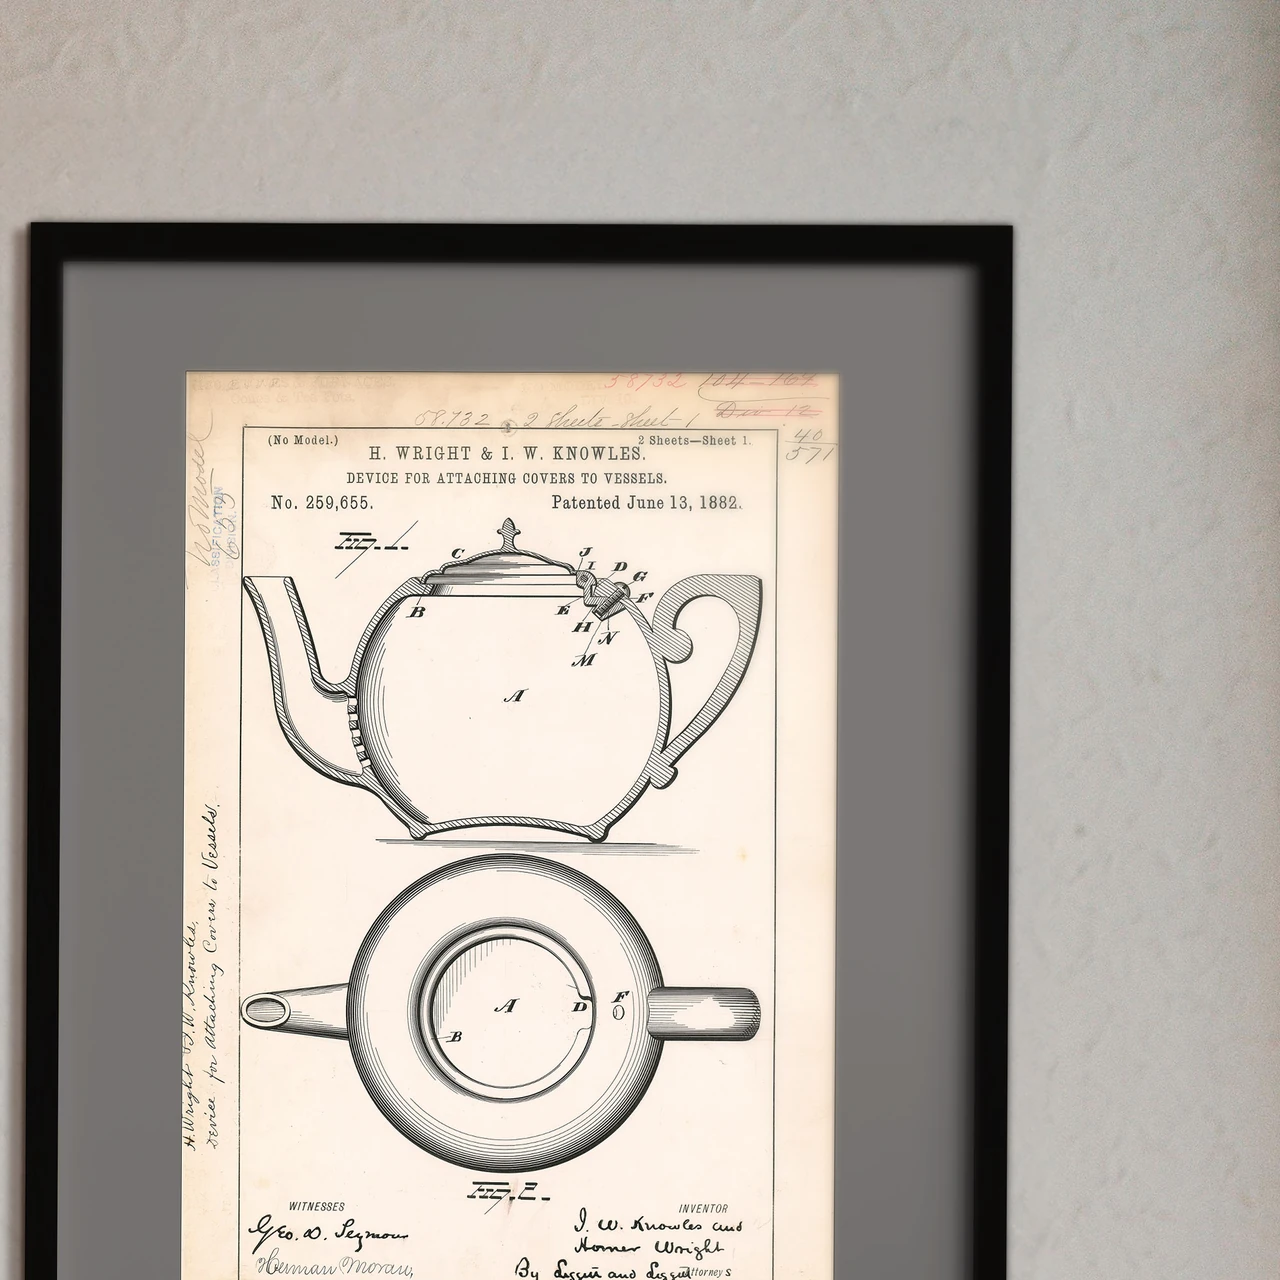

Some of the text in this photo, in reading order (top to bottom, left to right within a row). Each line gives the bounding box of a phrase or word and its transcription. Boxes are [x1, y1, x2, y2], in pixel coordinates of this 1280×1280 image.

[267, 434, 339, 447] (No Model.)
[638, 435, 645, 446] 2
[368, 446, 646, 461] H. WRIGHT & I. W. KNOWLES.
[346, 472, 668, 485] DEVICE FOR ATTACHING COVERS TO VESSELS.
[270, 495, 374, 512] No. 259,655.
[551, 494, 744, 512] Patented June 13, 1882.
[451, 548, 466, 559] C
[579, 547, 593, 558] J
[611, 562, 628, 572] D
[633, 571, 648, 583] G
[637, 592, 654, 603] F
[405, 606, 428, 619] B
[554, 605, 574, 616] E
[571, 621, 594, 633] H
[597, 631, 620, 645] N
[570, 652, 598, 667] M
[503, 688, 530, 703] A
[611, 991, 630, 1003] F
[493, 997, 522, 1014] A
[571, 1002, 587, 1013] D
[448, 1031, 462, 1043] B
[289, 1201, 346, 1212] WITNESSES
[678, 1203, 729, 1214] INVENTOR
[630, 1216, 702, 1233] Knowles
[712, 1221, 743, 1232] and
[608, 1269, 637, 1279] and
